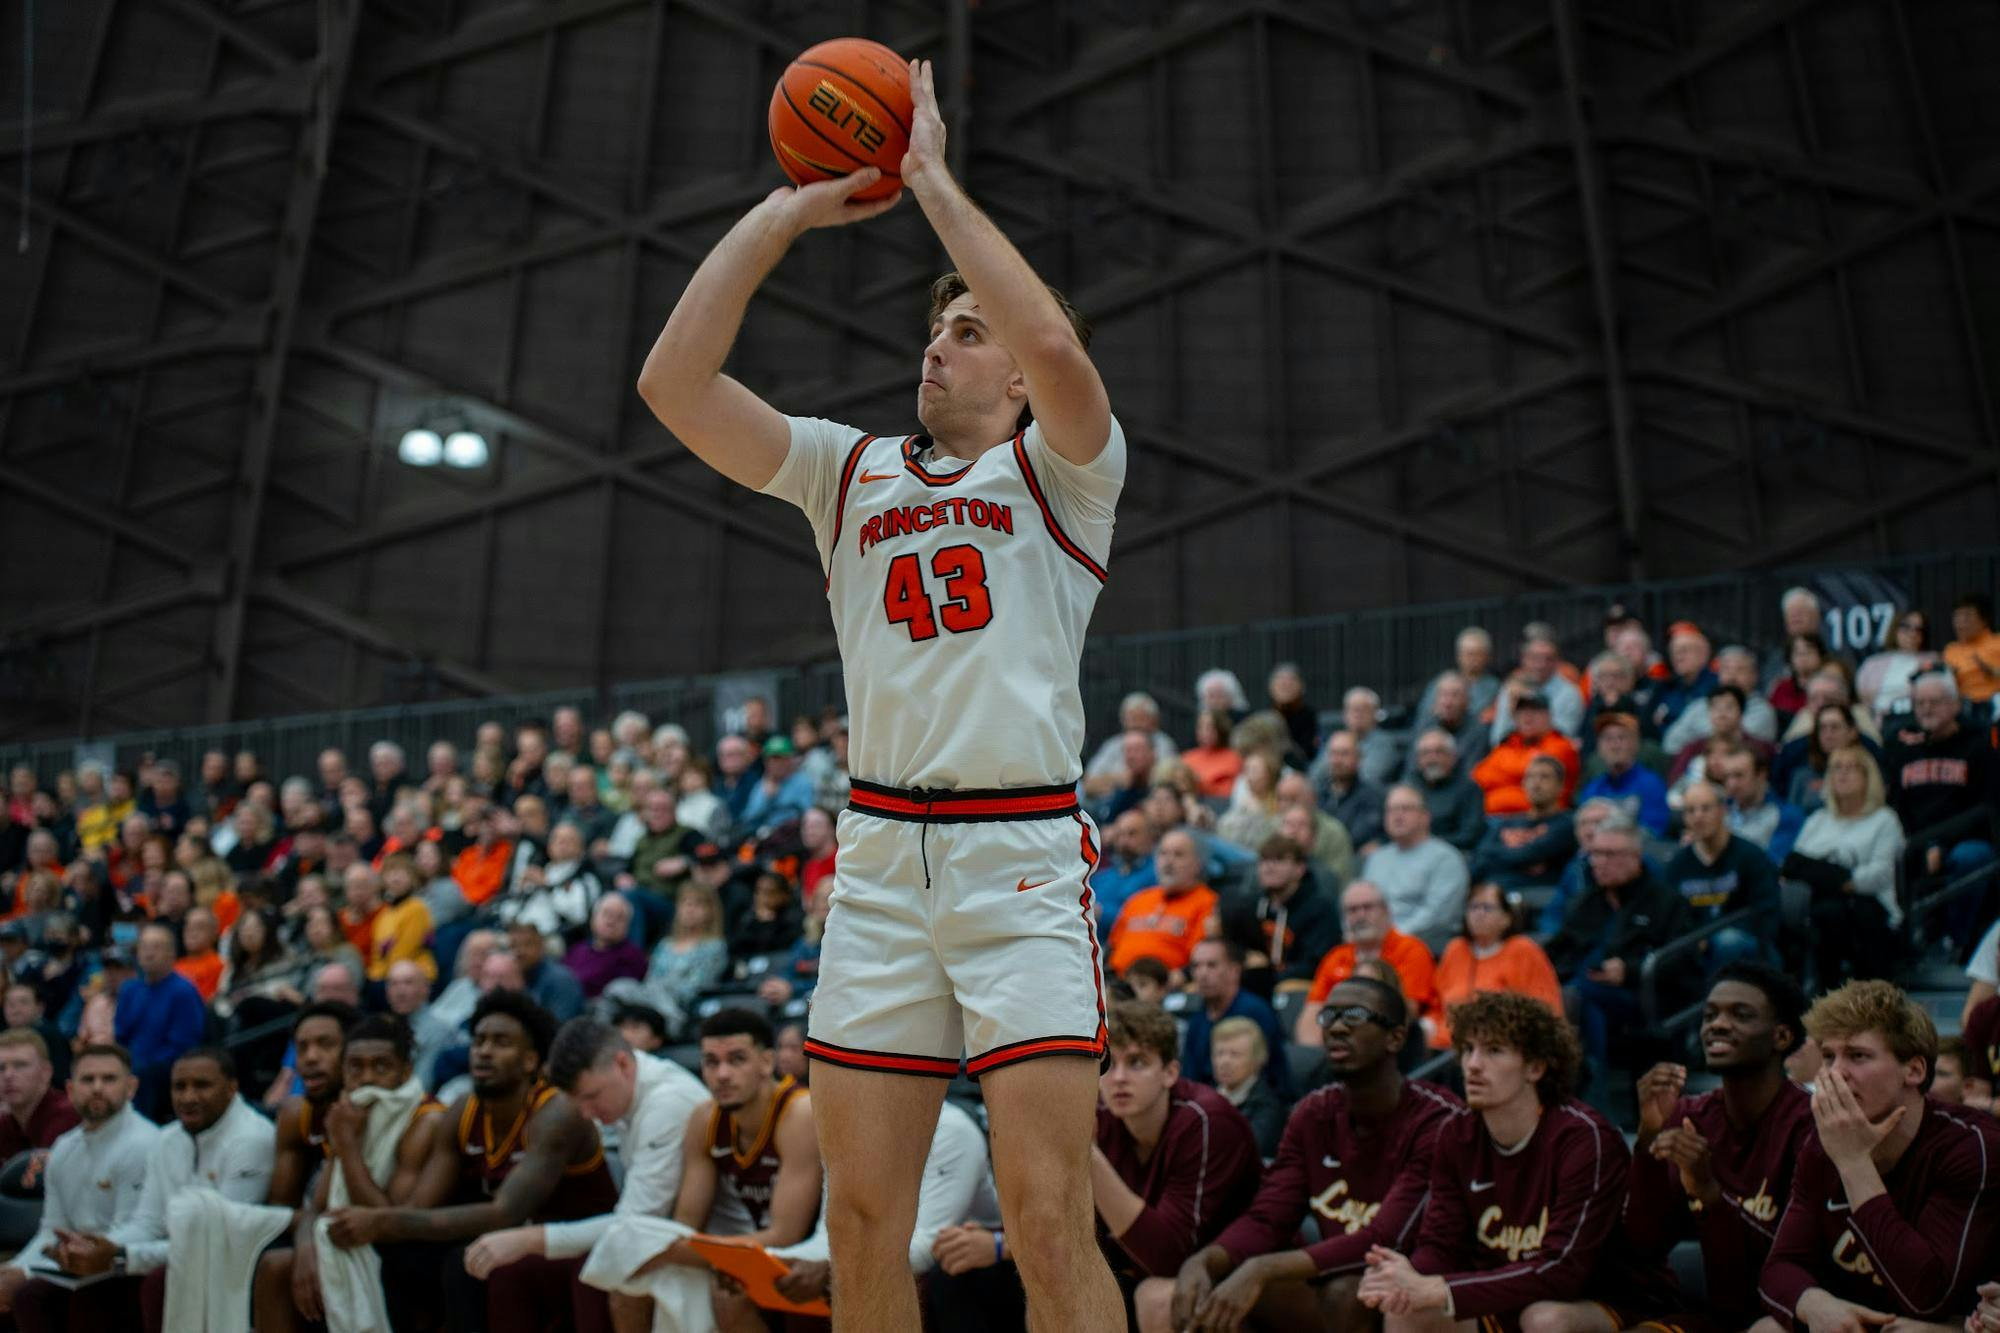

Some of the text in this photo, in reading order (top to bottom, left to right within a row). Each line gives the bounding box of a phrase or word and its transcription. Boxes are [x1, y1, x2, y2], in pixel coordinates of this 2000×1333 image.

[808, 87, 886, 153] ELITE
[858, 497, 1015, 557] PRINCETON
[883, 543, 993, 642] 43
[1825, 602, 1895, 651] 107
